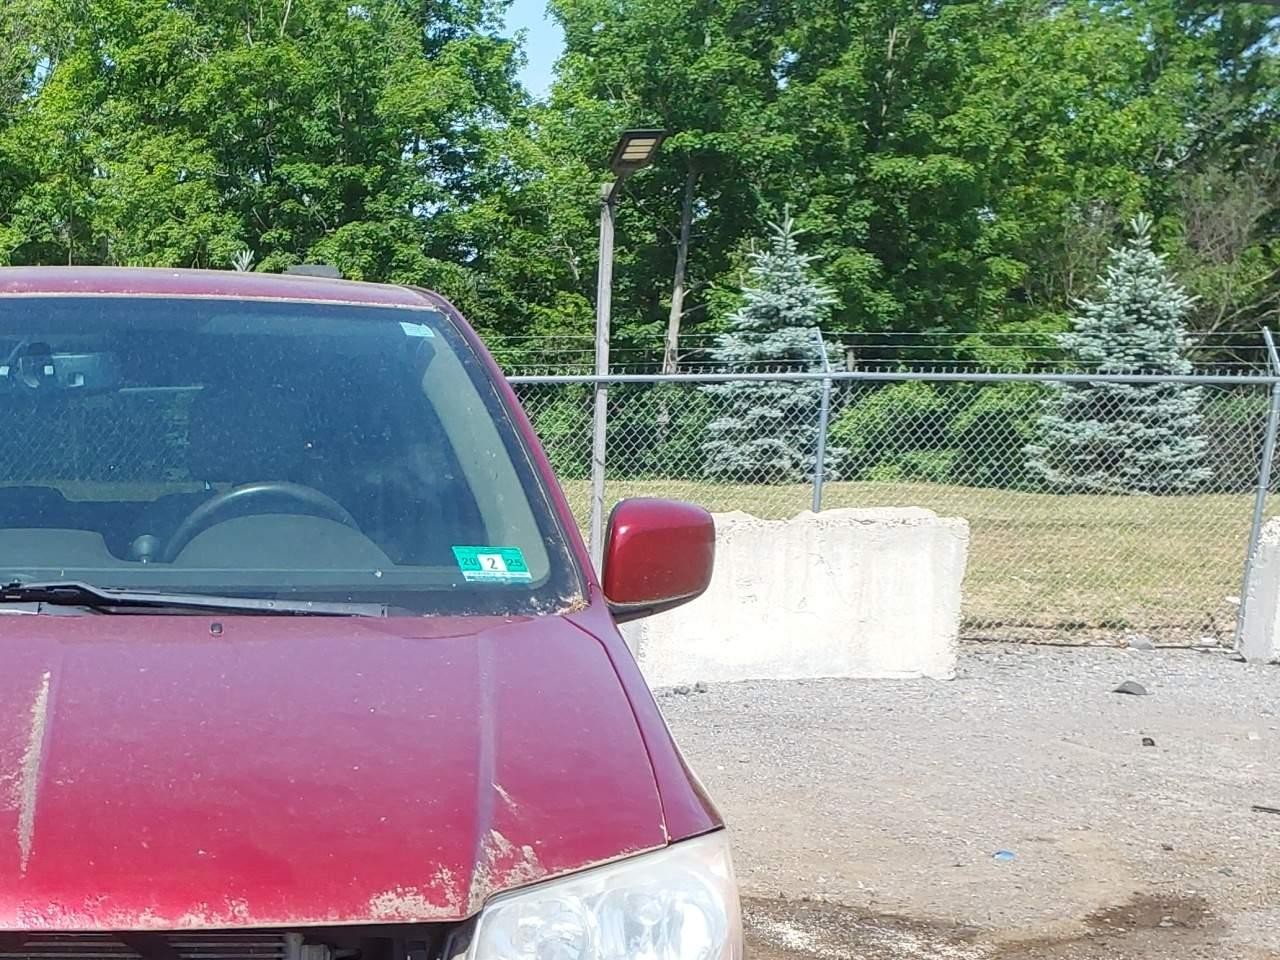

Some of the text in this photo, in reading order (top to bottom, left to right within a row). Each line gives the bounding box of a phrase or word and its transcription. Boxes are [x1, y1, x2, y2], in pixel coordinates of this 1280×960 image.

[461, 557, 523, 570] 20 2 25
